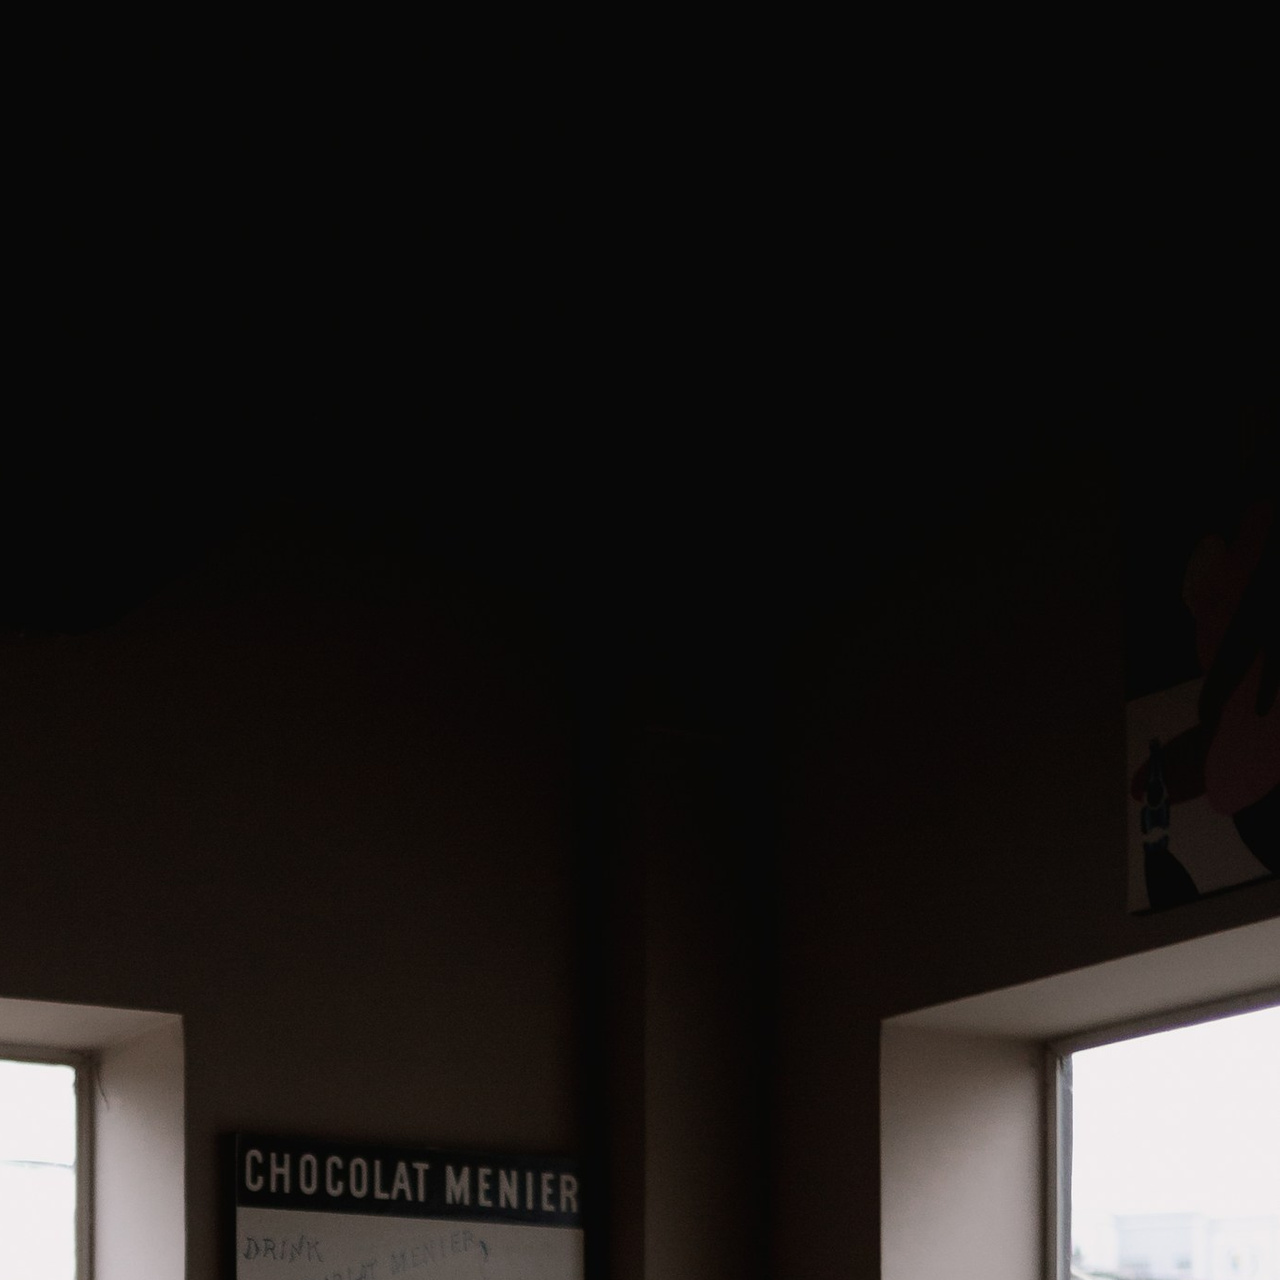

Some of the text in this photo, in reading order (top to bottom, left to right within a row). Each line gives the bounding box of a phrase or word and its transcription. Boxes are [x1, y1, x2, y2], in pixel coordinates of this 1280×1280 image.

[244, 1148, 579, 1214] CHOCOLAT MENIER
[242, 1234, 325, 1264] DRINK
[390, 1229, 475, 1276] MENIER
